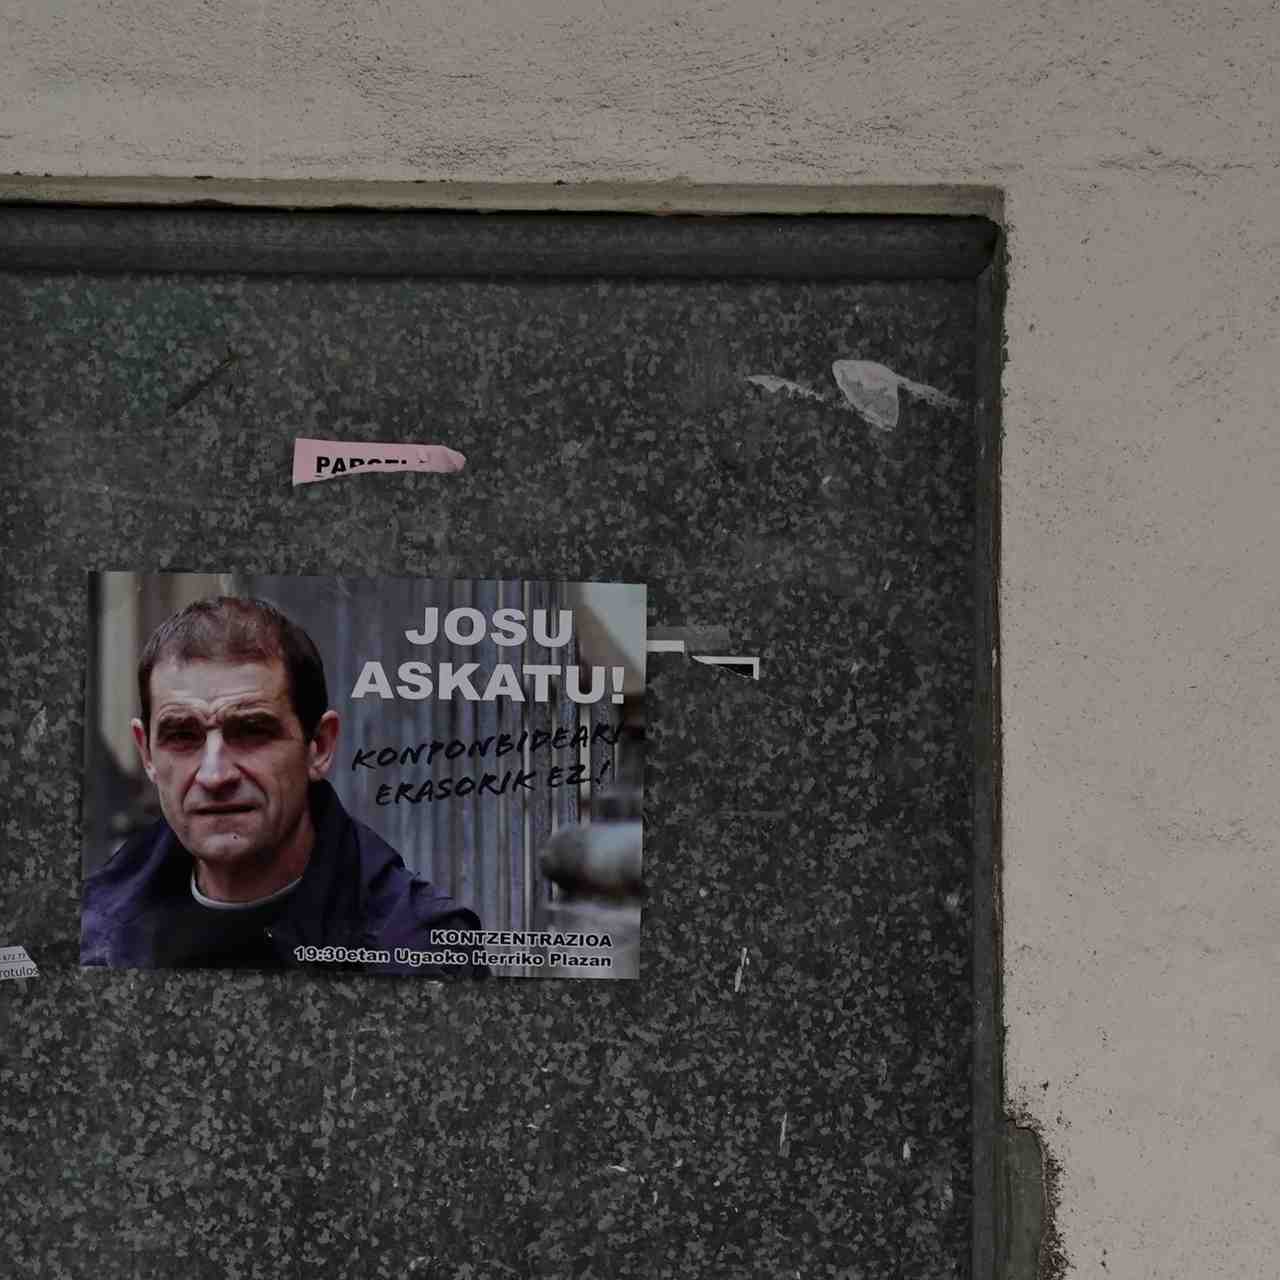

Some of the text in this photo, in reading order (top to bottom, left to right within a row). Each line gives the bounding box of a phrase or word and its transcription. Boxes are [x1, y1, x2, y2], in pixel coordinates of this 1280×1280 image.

[404, 607, 573, 648] JOSU
[351, 661, 625, 704] ASKATU!
[375, 759, 611, 806] ERASORIK EZ!
[294, 946, 612, 968] 19:30etan Ugaoko Herriko Plazan
[431, 929, 612, 948] KONTZENTRAZIOA
